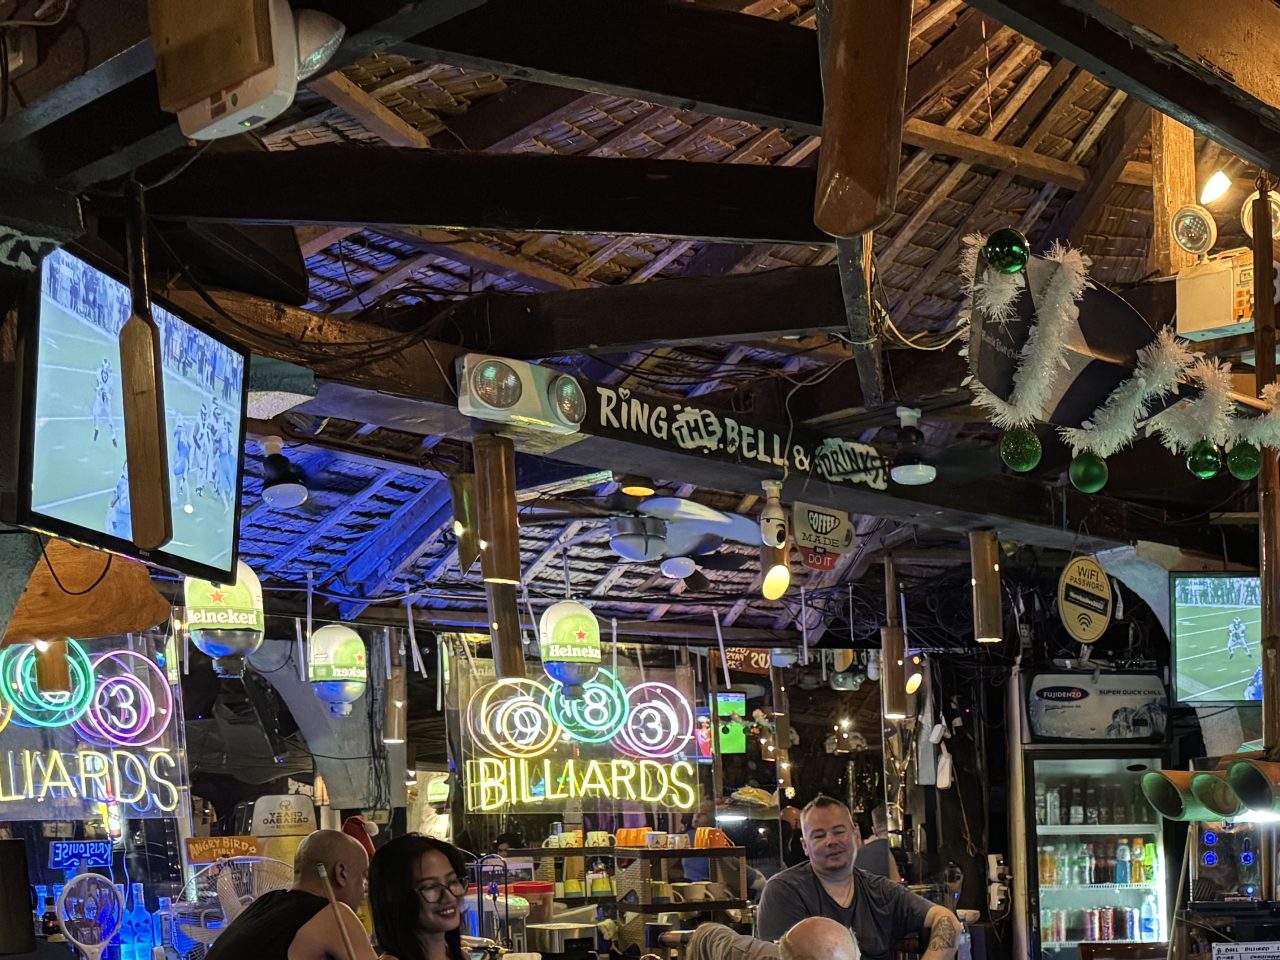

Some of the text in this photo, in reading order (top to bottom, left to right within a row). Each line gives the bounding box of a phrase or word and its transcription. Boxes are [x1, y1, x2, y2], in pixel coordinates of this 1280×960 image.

[597, 386, 668, 440] RING
[675, 416, 719, 443] THE
[725, 417, 788, 468] BELL
[793, 445, 811, 472] &
[808, 511, 838, 534] COFFEE
[801, 532, 839, 548] MADE
[808, 553, 832, 567] DO IT
[1070, 575, 1105, 592] PASSWORD
[479, 756, 695, 811] BILLIARDS
[188, 838, 220, 860] ANGRY
